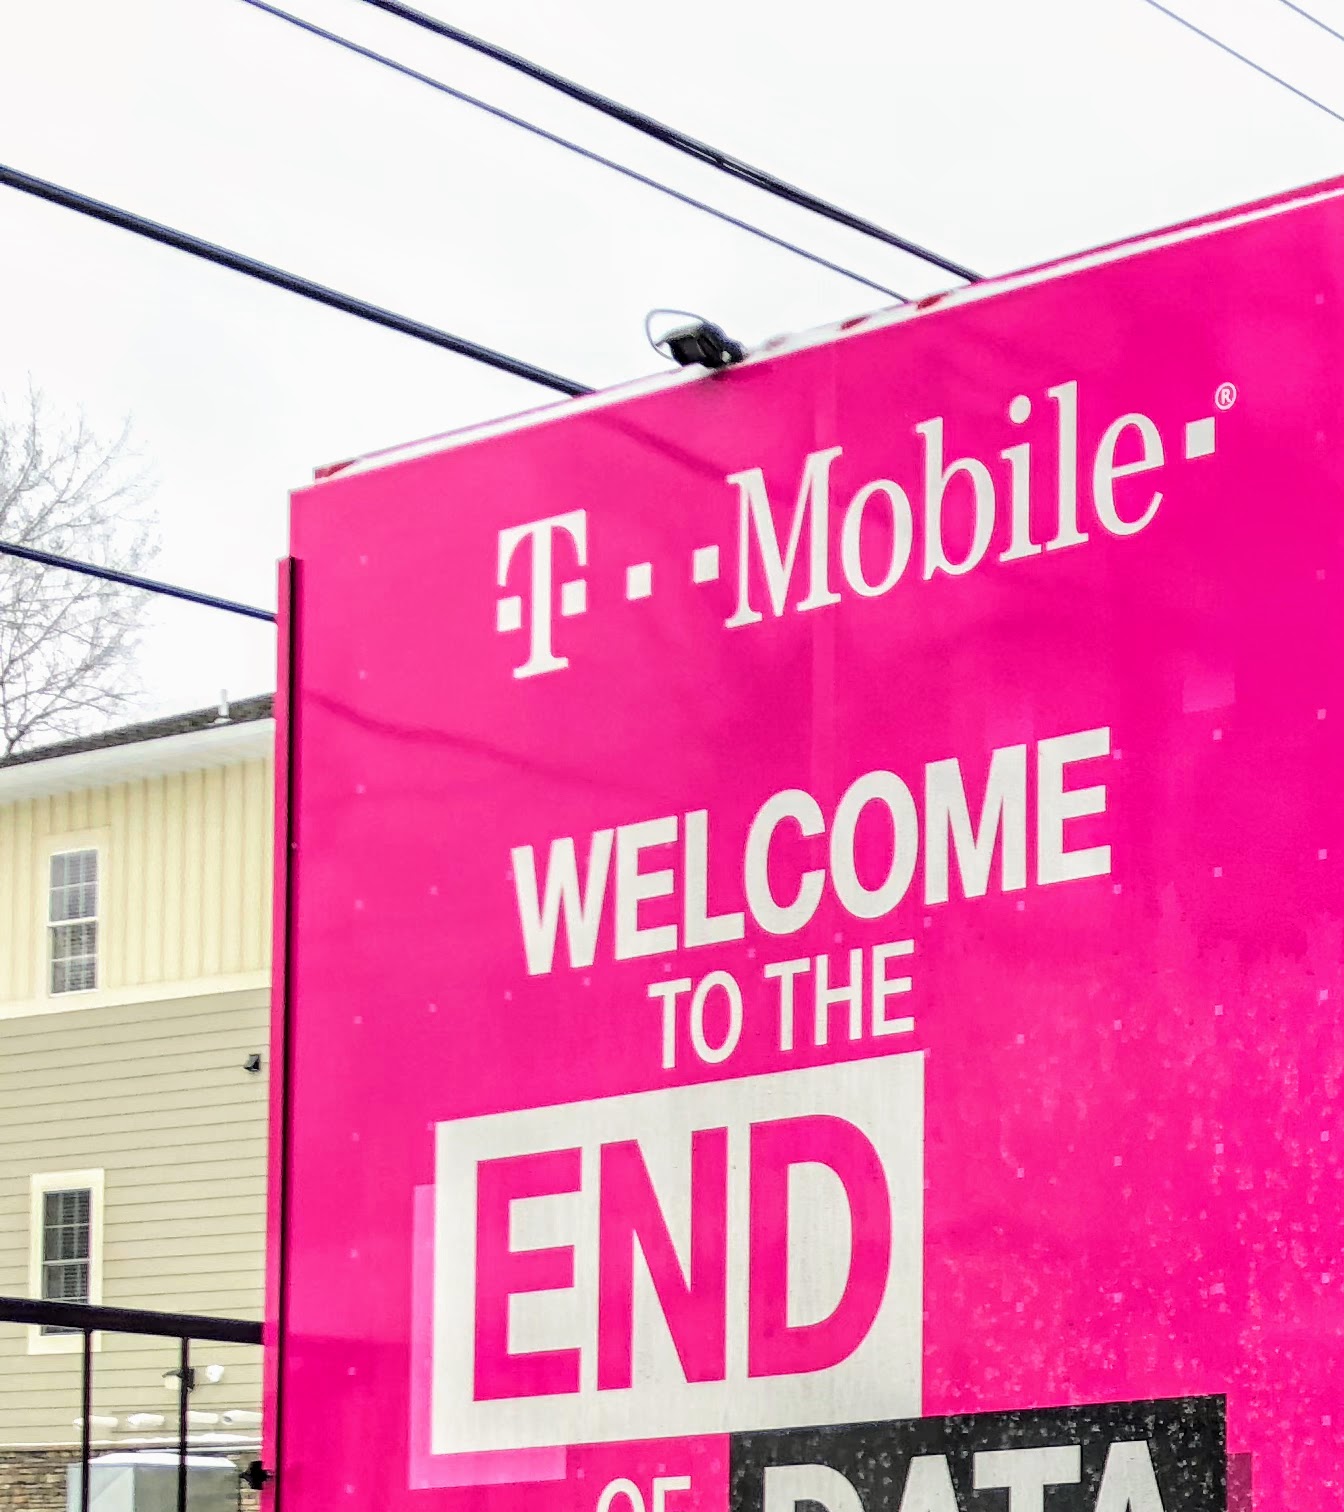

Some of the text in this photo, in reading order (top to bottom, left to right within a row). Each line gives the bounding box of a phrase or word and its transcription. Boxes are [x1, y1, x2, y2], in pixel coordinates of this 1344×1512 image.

[510, 726, 1112, 976] WELCOME
[649, 939, 917, 1070] TO THE
[473, 1113, 892, 1403] END
